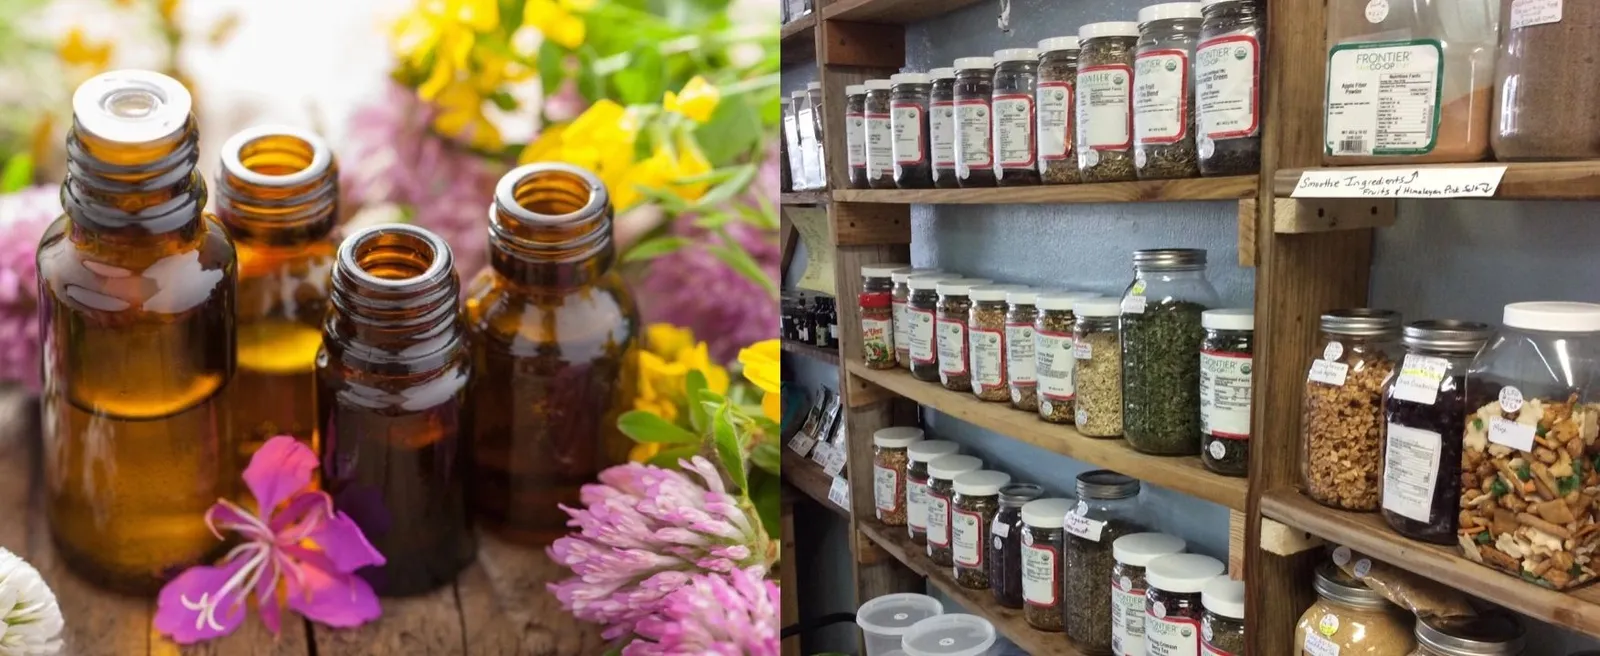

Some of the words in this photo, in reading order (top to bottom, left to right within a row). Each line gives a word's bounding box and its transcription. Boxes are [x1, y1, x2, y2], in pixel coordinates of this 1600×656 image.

[1356, 51, 1410, 64] FRONTIER
[1369, 62, 1395, 71] CO-OP
[1300, 177, 1339, 189] Smoothie
[1343, 175, 1405, 190] Ingredients
[1362, 187, 1390, 196] Fruits
